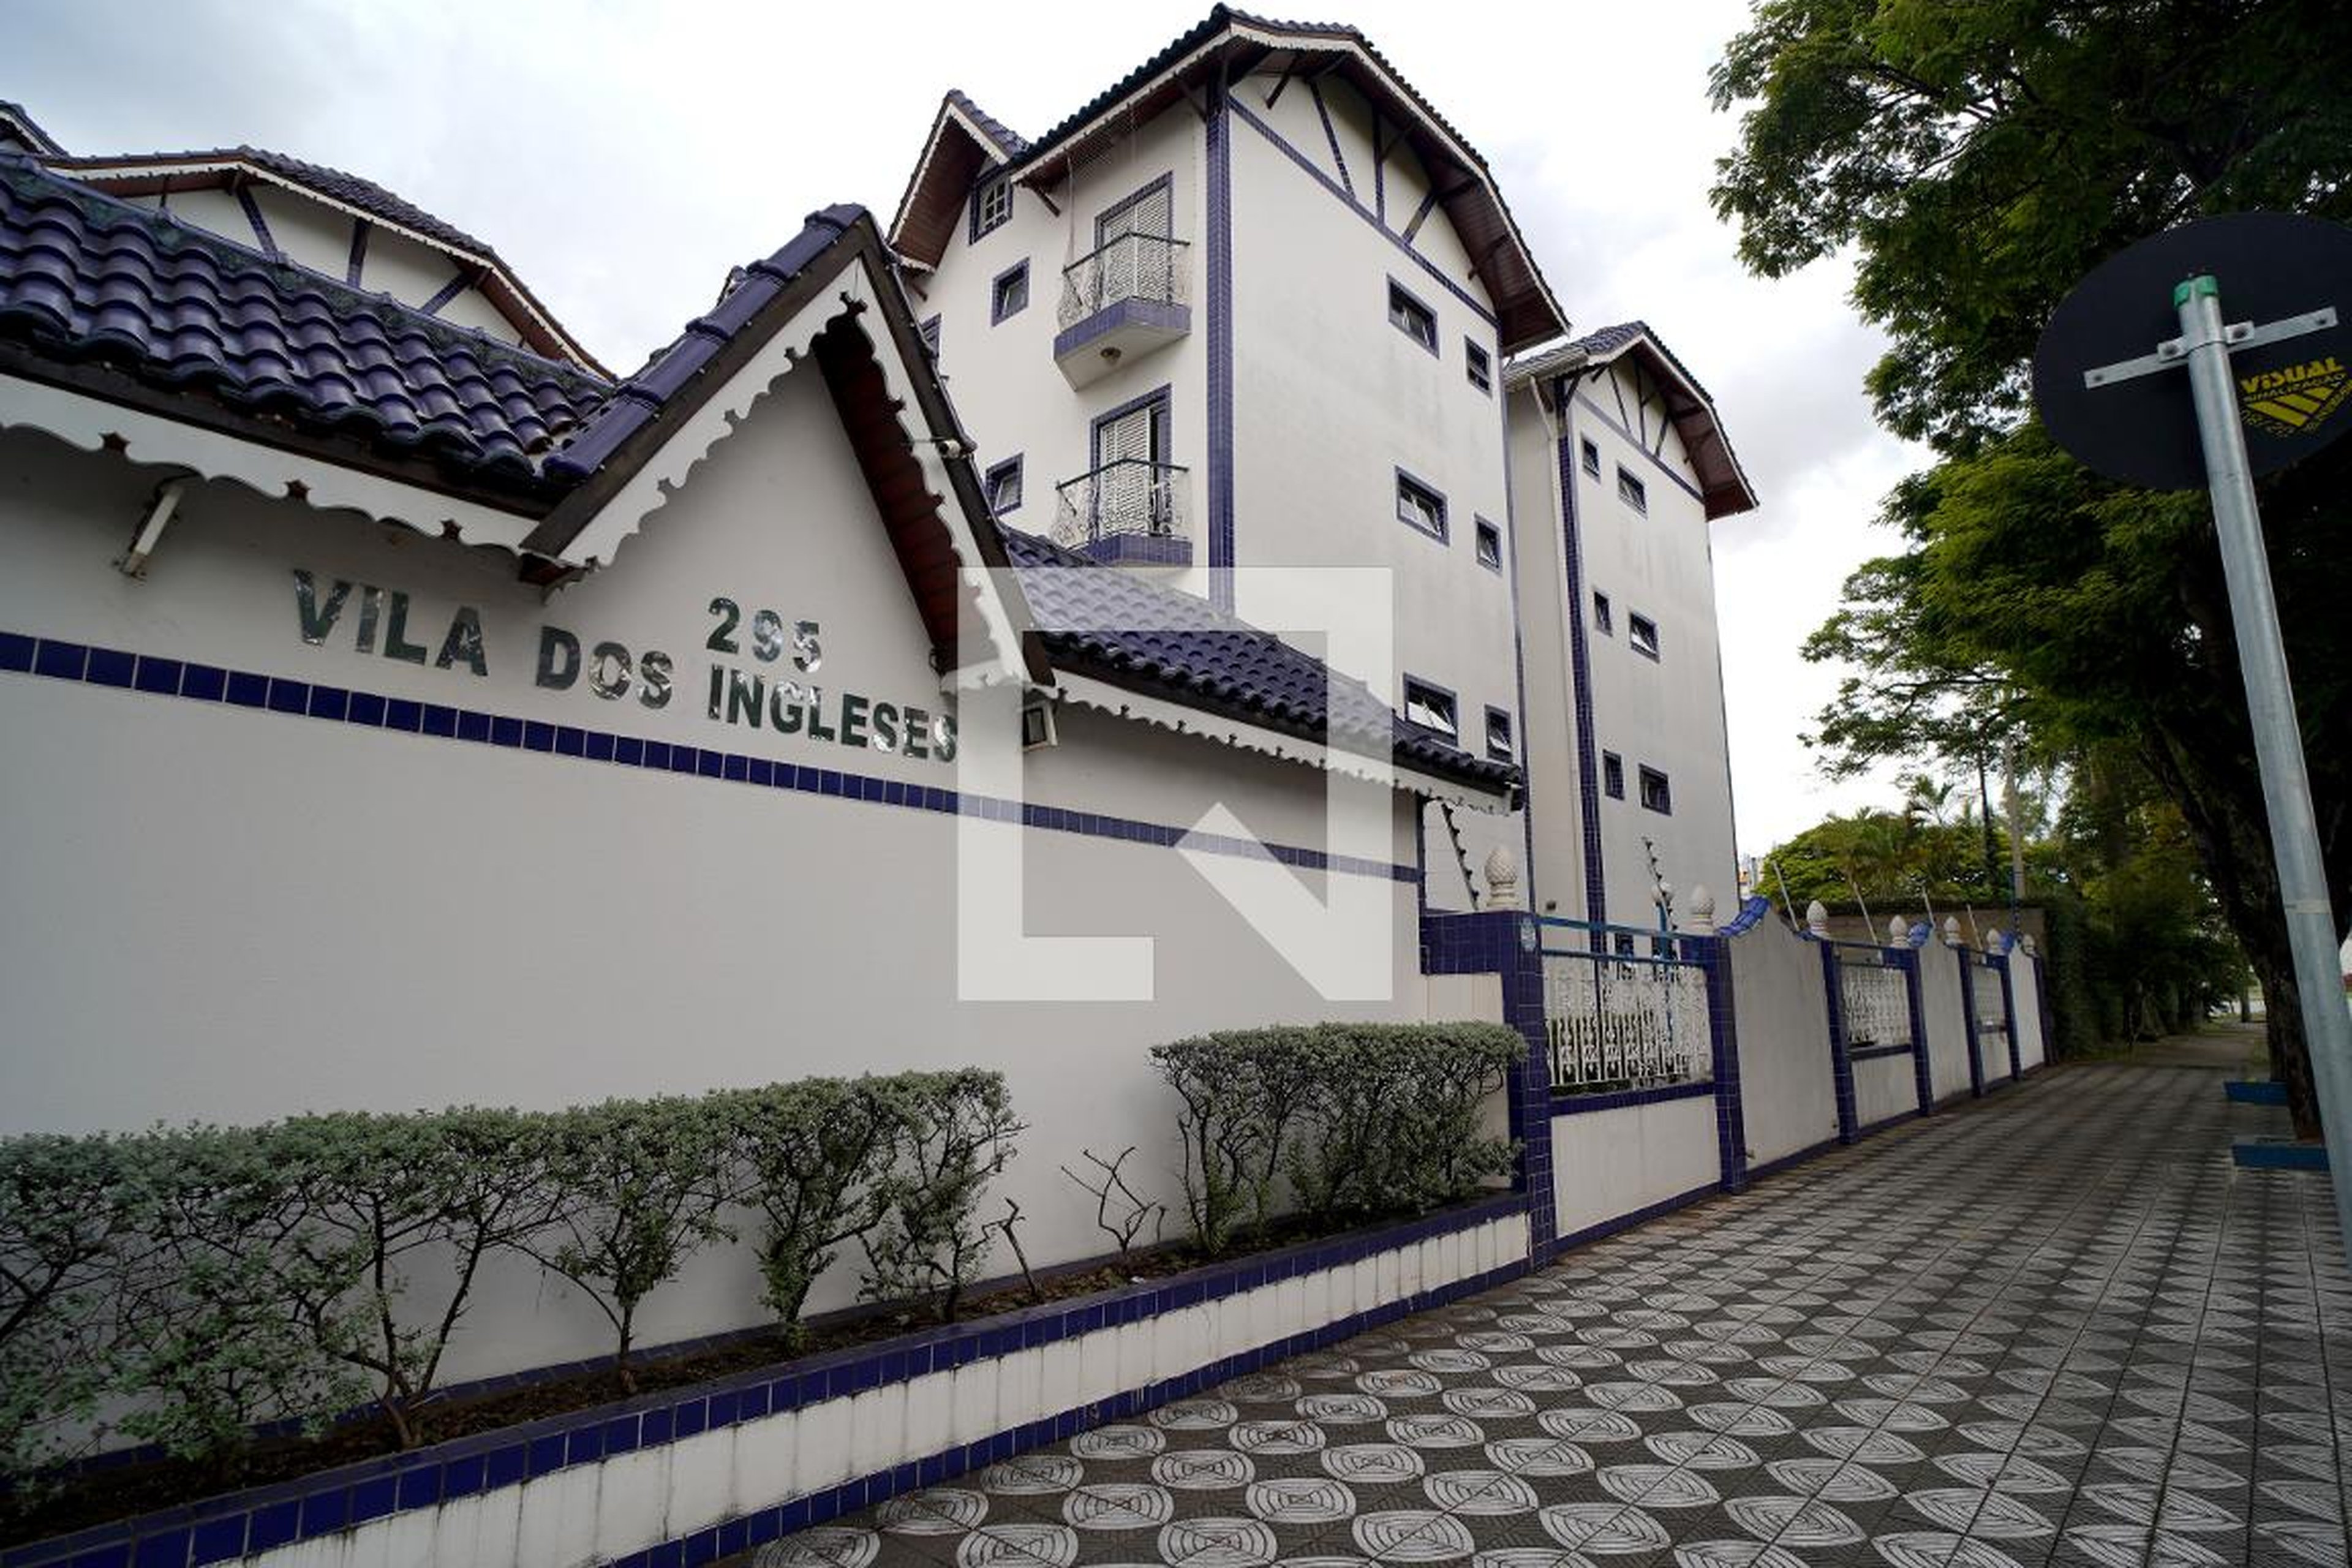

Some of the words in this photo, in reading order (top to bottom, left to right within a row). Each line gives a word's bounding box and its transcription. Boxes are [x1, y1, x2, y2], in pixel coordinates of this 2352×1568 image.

[293, 569, 488, 676] VILA
[535, 625, 674, 709] DOS
[707, 663, 958, 763] INGLESES
[706, 597, 822, 673] 295
